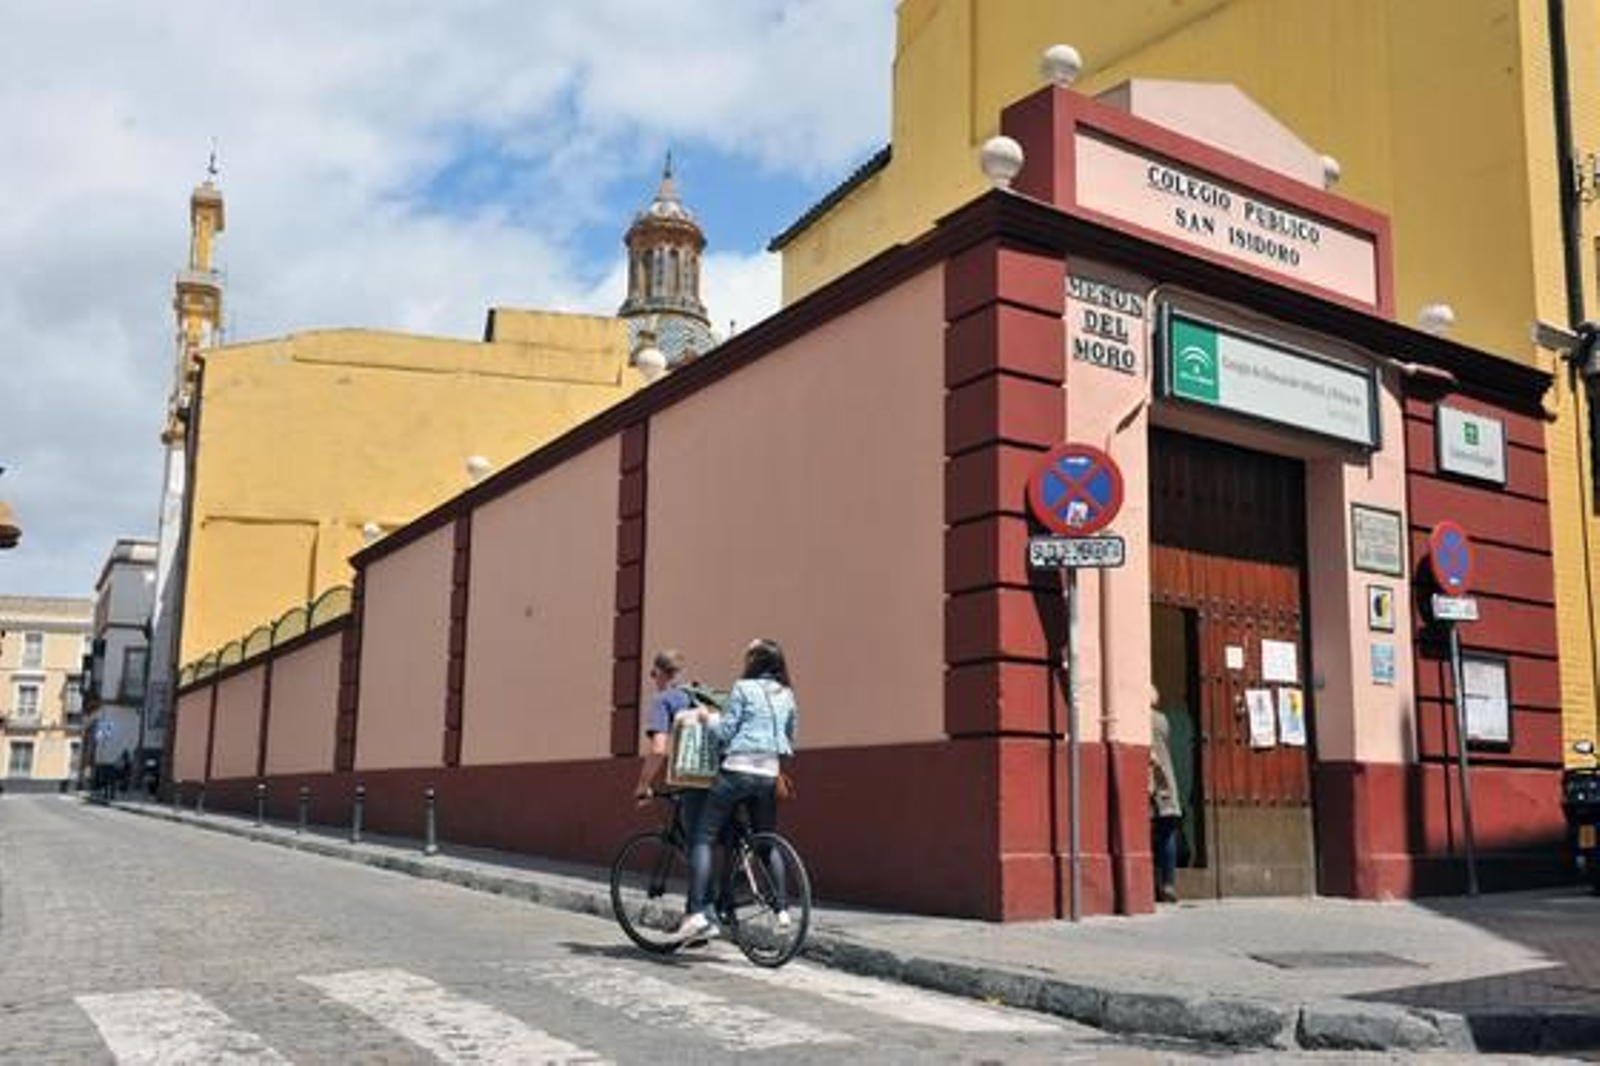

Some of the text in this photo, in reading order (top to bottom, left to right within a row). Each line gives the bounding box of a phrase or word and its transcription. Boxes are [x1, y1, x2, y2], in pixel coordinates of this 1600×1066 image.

[1148, 165, 1232, 209] COLEGIO
[1174, 206, 1301, 266] SAN ISIDORO
[1065, 276, 1143, 316] MESON
[1082, 310, 1129, 340] DEL
[1073, 338, 1136, 372] MORO
